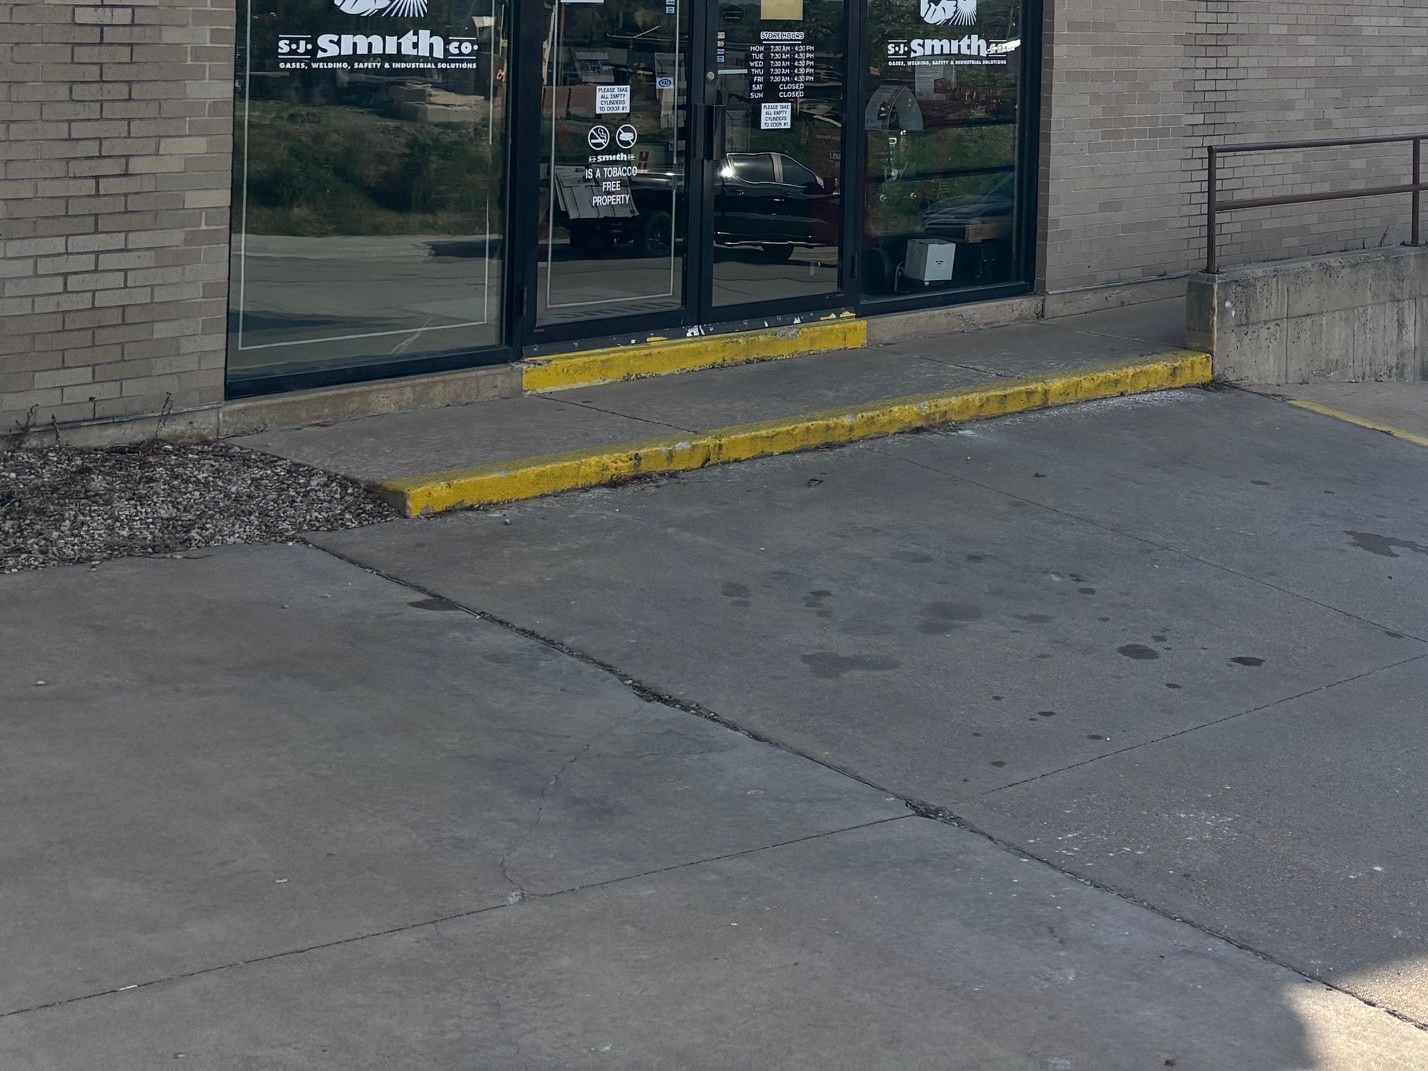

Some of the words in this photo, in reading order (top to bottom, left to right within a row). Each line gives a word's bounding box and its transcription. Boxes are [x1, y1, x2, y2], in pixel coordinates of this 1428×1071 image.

[760, 31, 781, 40] STORE
[781, 31, 804, 40] HOURS
[585, 169, 593, 179] IS
[595, 168, 601, 178] A
[603, 165, 638, 178] TOBACCO
[602, 181, 621, 192] FREE
[592, 193, 631, 206] PROPERTY
